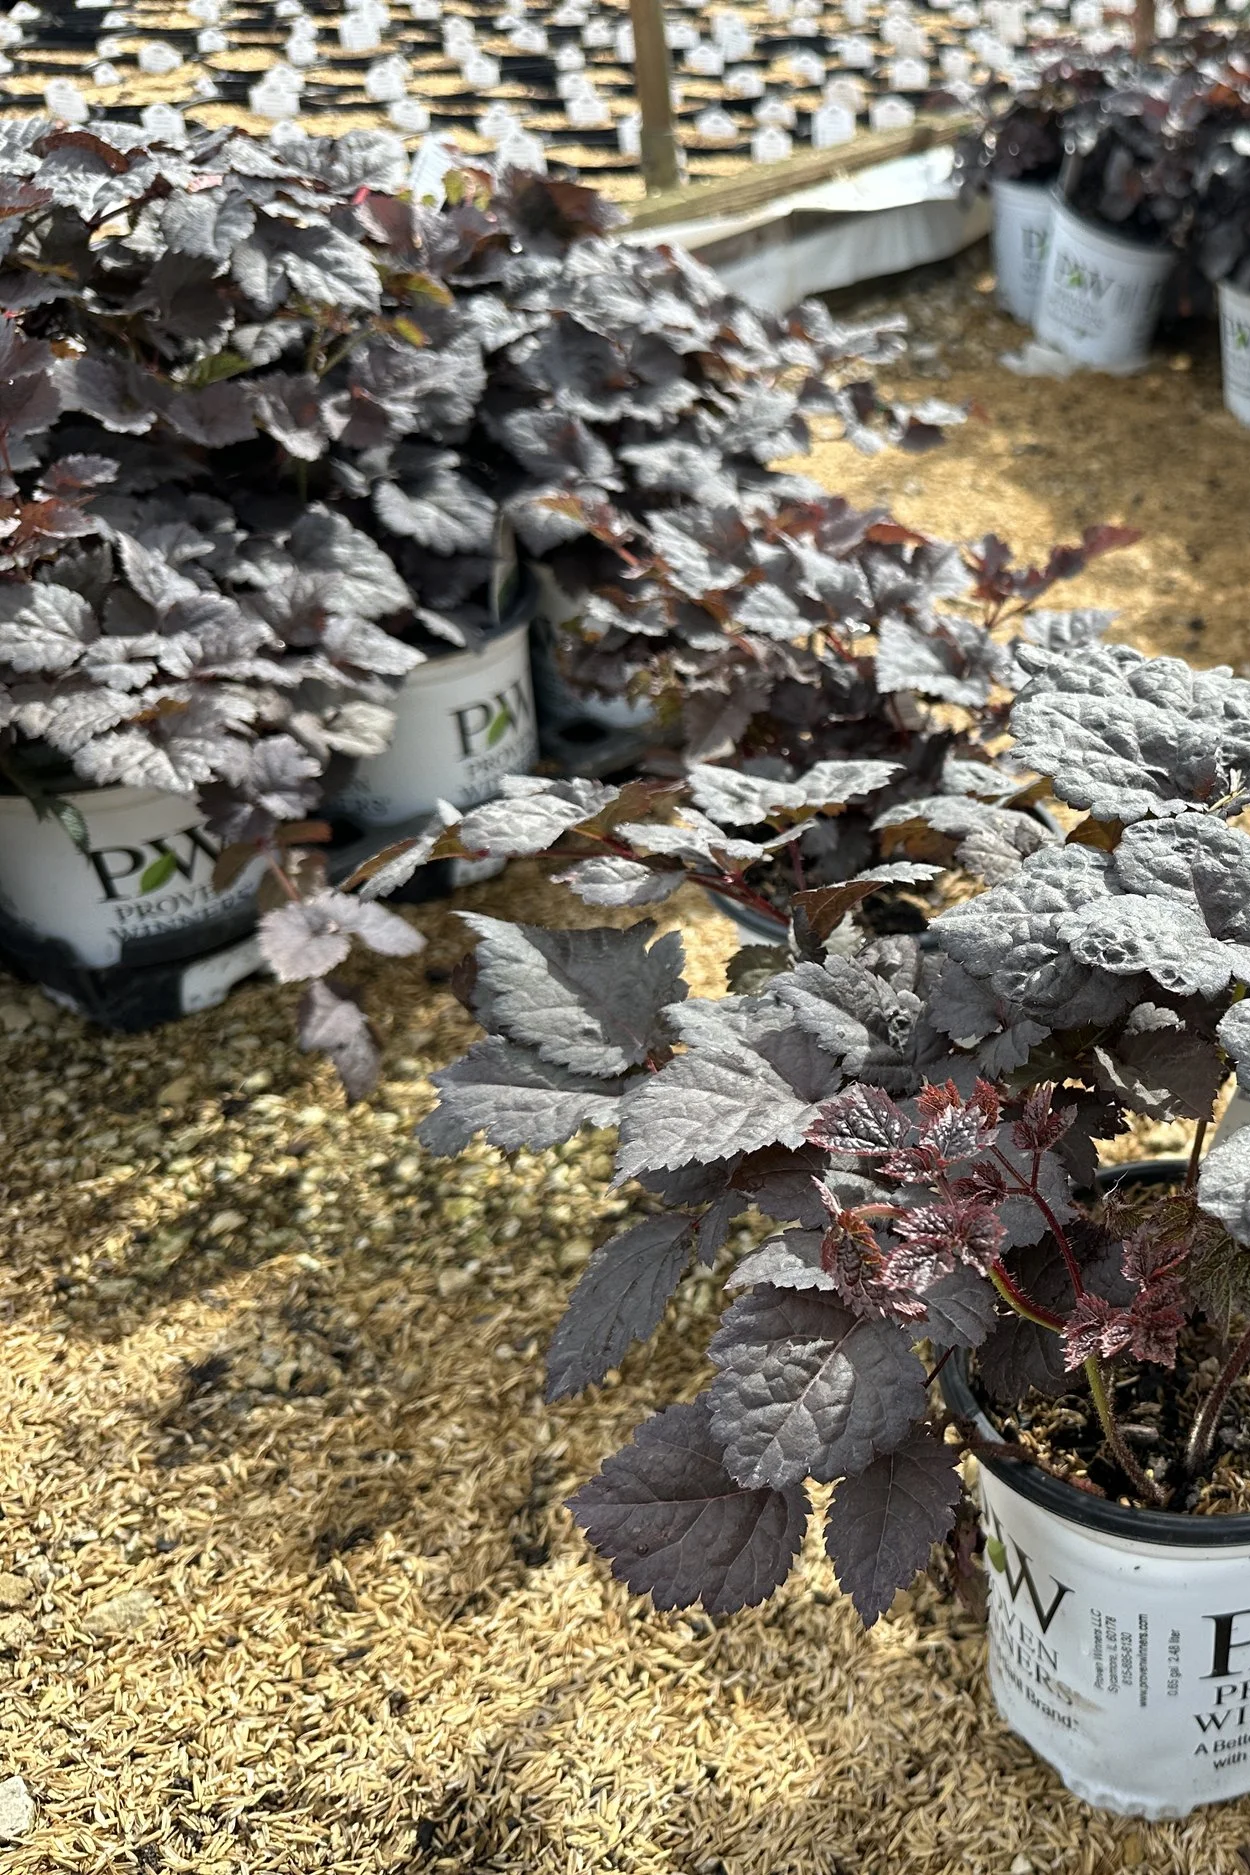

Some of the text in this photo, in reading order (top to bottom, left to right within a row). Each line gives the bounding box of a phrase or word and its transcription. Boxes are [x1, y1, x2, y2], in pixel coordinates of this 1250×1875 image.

[449, 680, 532, 762] PW
[114, 884, 216, 924] PROVE
[1091, 1608, 1103, 1690] Proven Winners LLC
[1169, 1629, 1180, 1643] liter
[1139, 1613, 1148, 1707] www.provenwinners.com
[1168, 1665, 1182, 1678] gal
[1194, 1743, 1208, 1755] A
[1213, 1751, 1247, 1770] with
